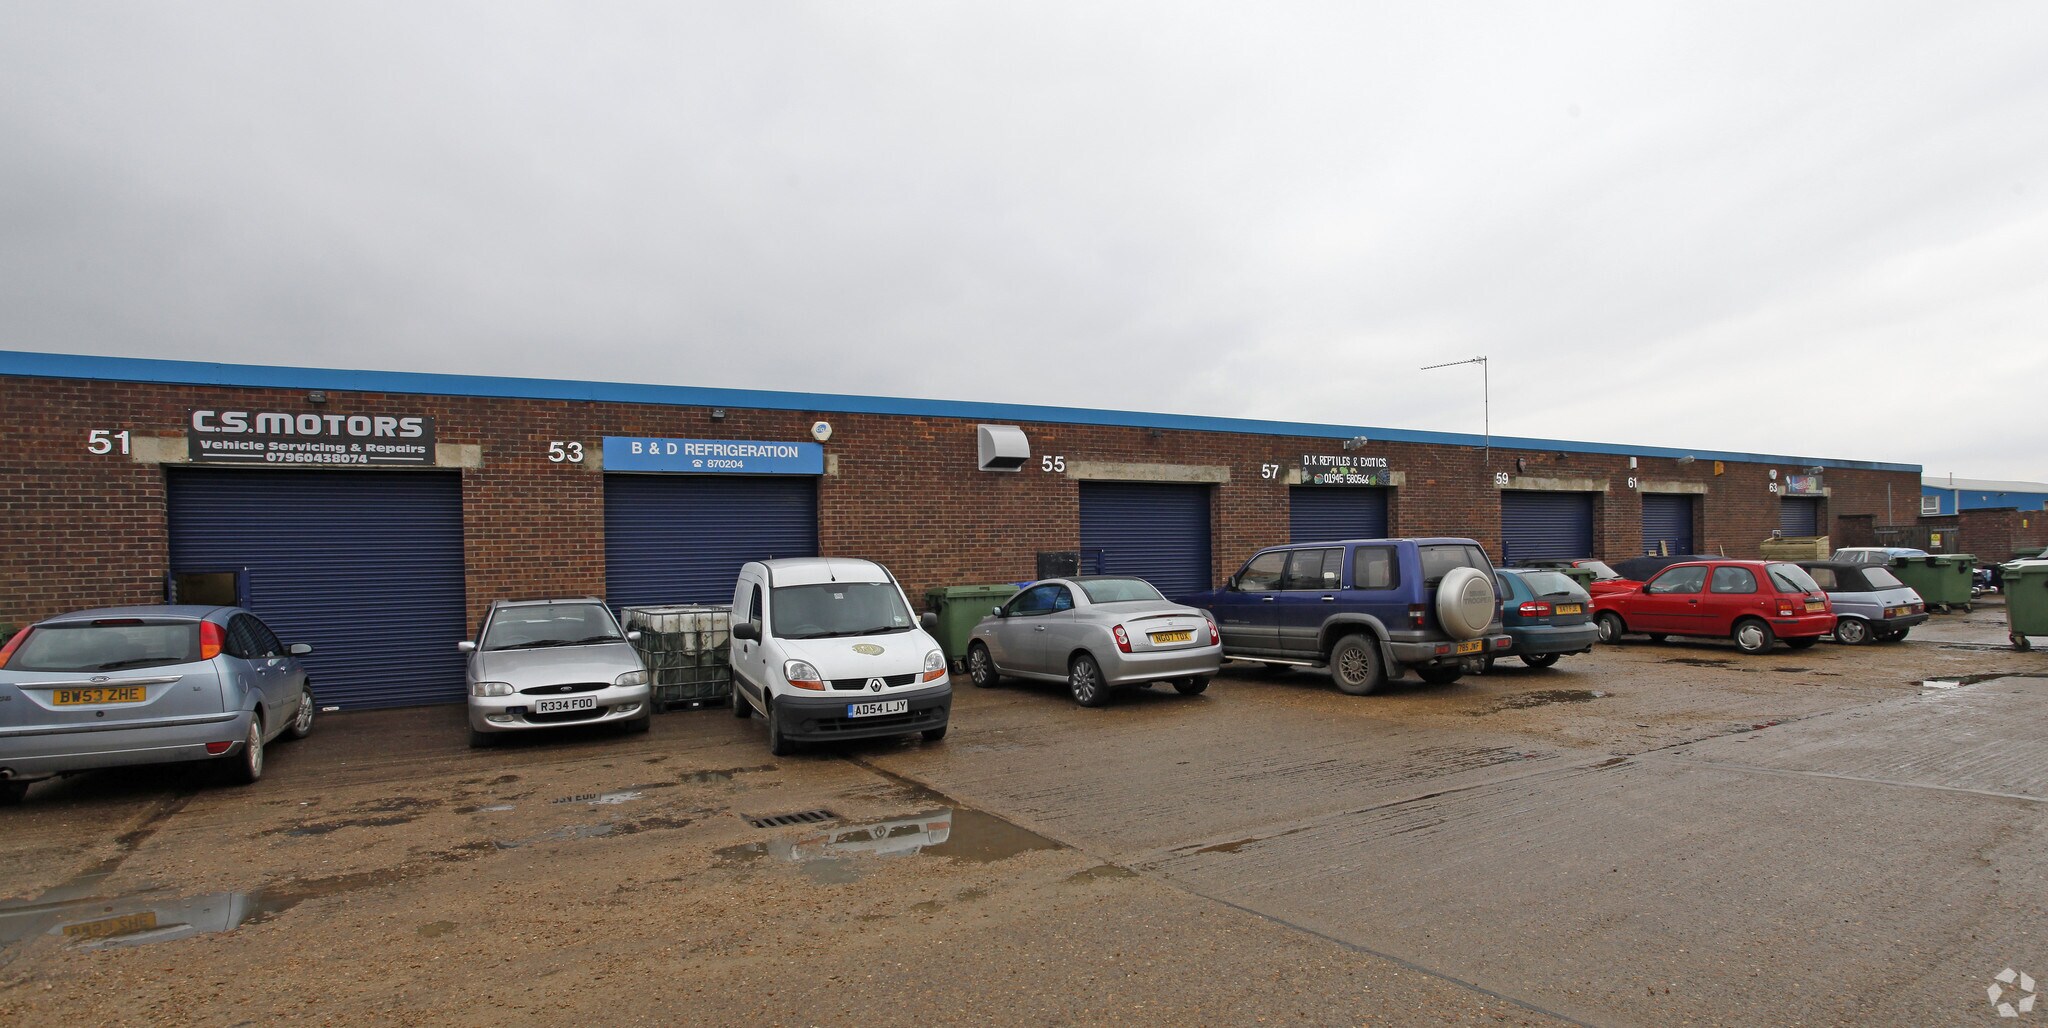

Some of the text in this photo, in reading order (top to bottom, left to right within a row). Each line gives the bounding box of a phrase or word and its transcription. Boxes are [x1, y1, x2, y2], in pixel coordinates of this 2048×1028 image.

[87, 429, 130, 455] 51
[200, 440, 426, 454] Vehicle Servicing & Repairs
[548, 441, 584, 463] 53
[631, 441, 799, 458] B & D REFRIGERATION
[266, 452, 368, 464] 07960438074
[707, 459, 744, 469] 870204
[1041, 455, 1066, 473] 55
[1319, 455, 1351, 467] REPTILES
[1261, 463, 1279, 479] 57
[1323, 473, 1369, 484] 01945 580566
[1495, 472, 1509, 485] 59
[1627, 477, 1637, 488] 61
[1769, 482, 1777, 492] 63
[1155, 633, 1174, 643] NG07
[60, 687, 140, 703] BW53 ZHE
[541, 701, 570, 712] R334
[855, 701, 907, 716] AD54 LJY
